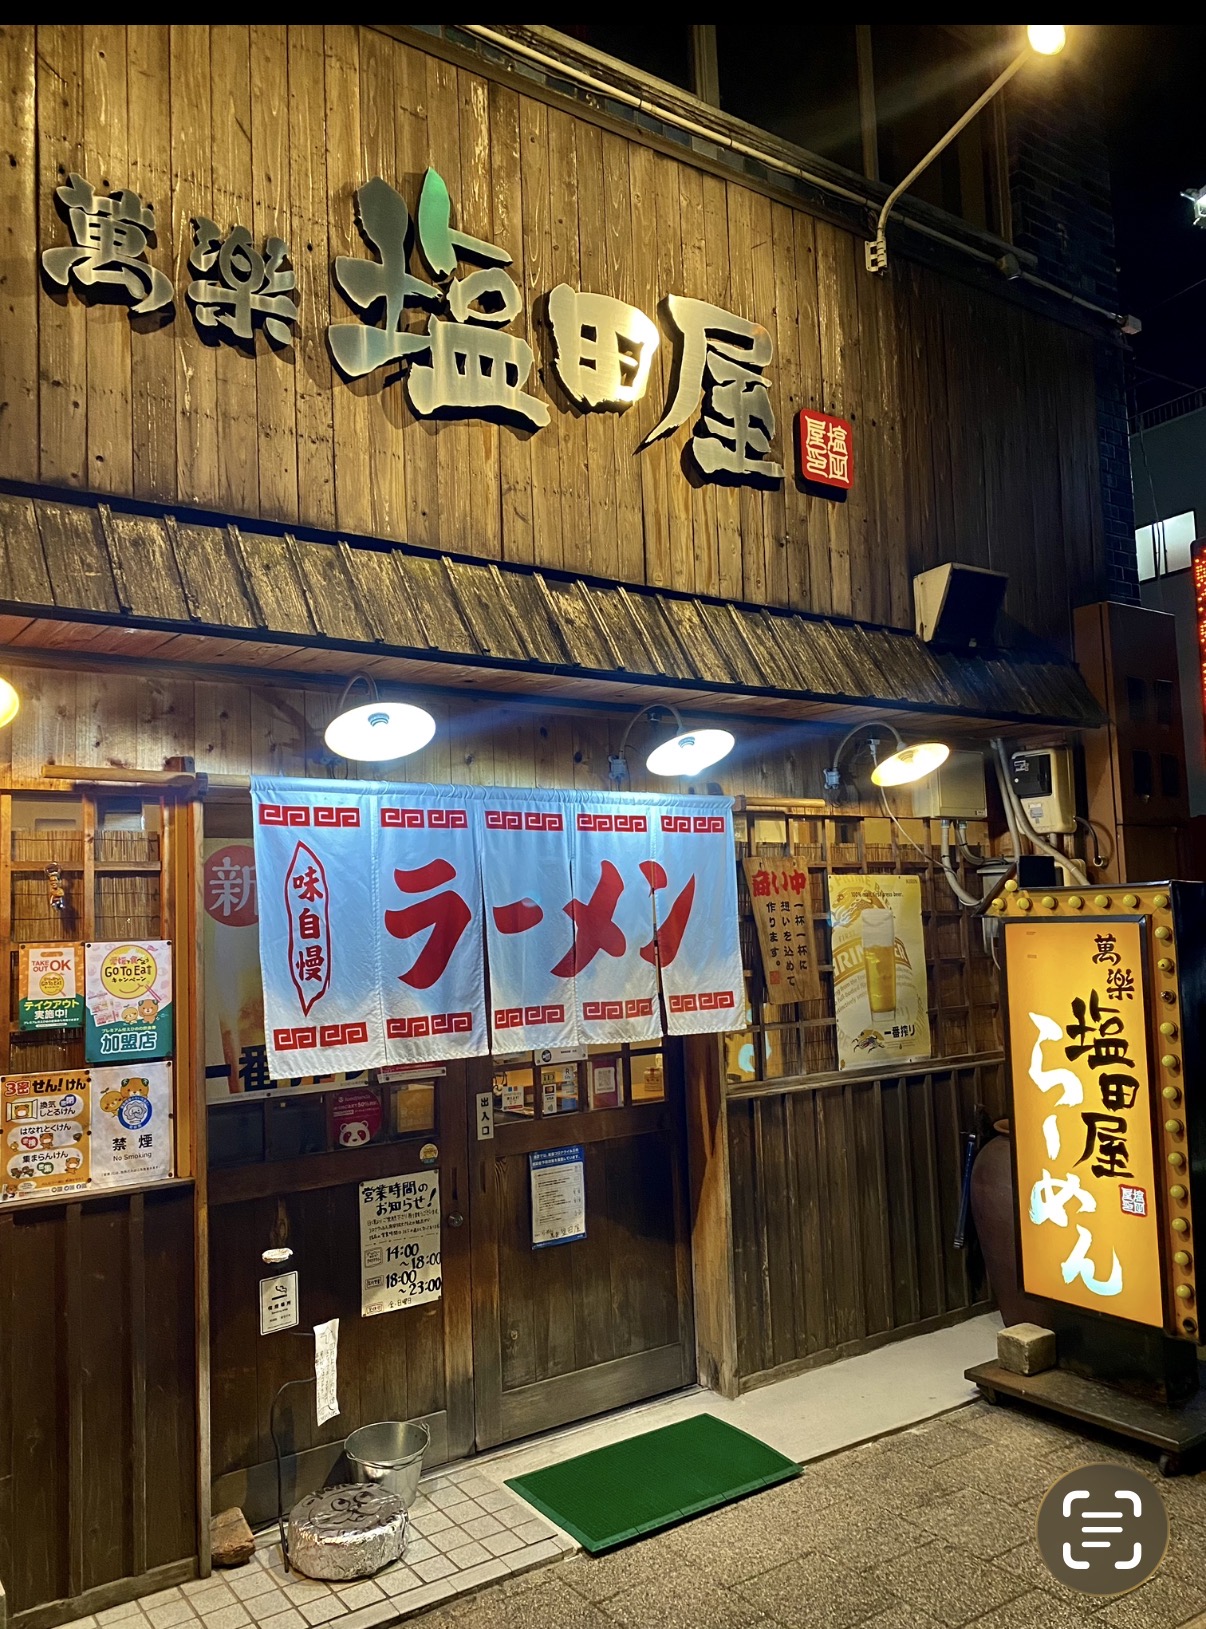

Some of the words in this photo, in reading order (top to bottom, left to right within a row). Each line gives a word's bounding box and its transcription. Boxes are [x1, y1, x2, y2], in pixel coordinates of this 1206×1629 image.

[327, 166, 785, 479] 塩田屋
[752, 869, 807, 897] 商い中
[291, 866, 325, 984] 味自慢
[384, 857, 696, 990] ラーメン
[766, 901, 781, 967] 作ります。
[780, 901, 796, 987] 想いを込めて
[794, 902, 808, 971] 一杯一杯に
[50, 960, 72, 972] OK
[105, 966, 119, 977] Go
[120, 966, 132, 976] To
[134, 965, 152, 975] Eat
[24, 1000, 80, 1011] テイクアウト
[101, 1031, 157, 1054] 加盟店
[884, 1024, 916, 1039] 一番搾り
[1064, 988, 1140, 1179] 塩田屋
[40, 1107, 76, 1117] しとるけん
[480, 1097, 490, 1136] 出入口
[20, 1123, 72, 1136] はなれとくけん
[22, 1151, 69, 1163] 集まらんけん
[123, 1152, 152, 1161] Smoking
[1028, 1011, 1123, 1297] らーめん
[362, 1180, 429, 1204] 営業時間の
[386, 1242, 420, 1263] 14:00
[386, 1269, 418, 1290] 18:00
